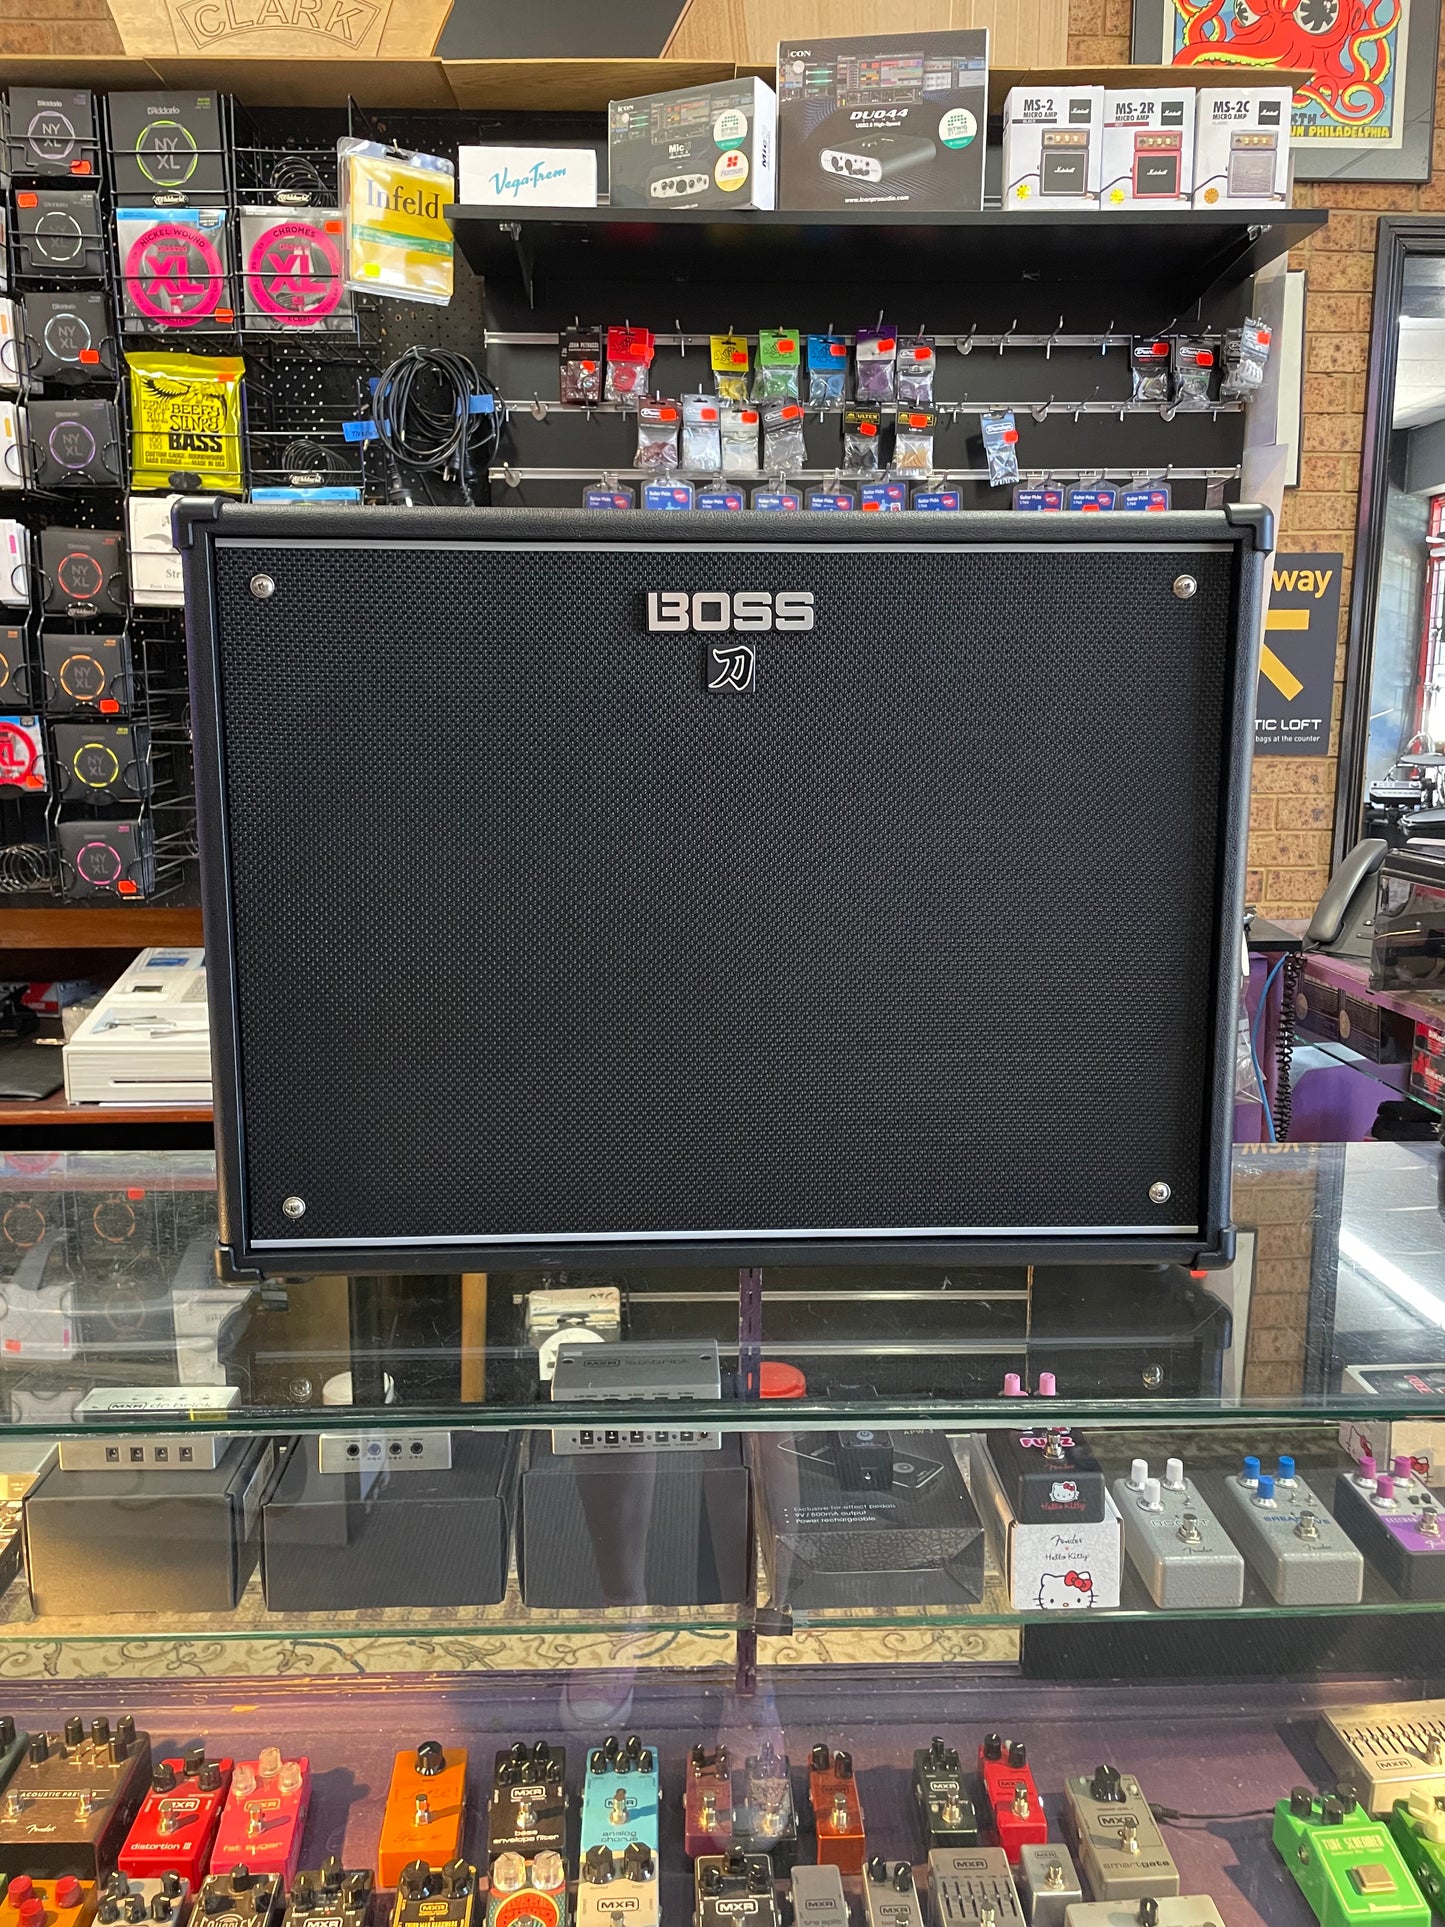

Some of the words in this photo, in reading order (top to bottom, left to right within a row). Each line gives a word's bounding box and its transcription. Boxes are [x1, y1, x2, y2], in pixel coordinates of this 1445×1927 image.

[194, 0, 364, 40] CLARK
[1023, 99, 1054, 112] MS-2
[1212, 100, 1250, 113] MS-2C
[42, 123, 60, 135] NY
[1308, 126, 1390, 138] PHILADELPHIA
[154, 137, 178, 151] NY
[157, 155, 180, 169] XL
[366, 178, 440, 220] Infeld
[273, 226, 316, 238] CHROMES
[140, 228, 171, 248] NICKEL
[173, 228, 206, 248] WOUND
[145, 255, 205, 295] XL
[267, 254, 327, 293] XL
[58, 326, 76, 337] NY
[60, 338, 78, 349] XL
[171, 404, 220, 415] BEEFY
[63, 433, 80, 443] NY
[168, 434, 223, 453] BASS
[66, 446, 83, 456] XL
[72, 565, 88, 575] NY
[72, 576, 90, 587] XL
[1272, 570, 1333, 599] way
[648, 592, 814, 631] BOSS
[74, 666, 91, 678] NY
[75, 678, 92, 689] XL
[1254, 719, 1277, 731] TIC
[1280, 719, 1323, 731] LOFT
[1255, 735, 1272, 744] bags
[1293, 735, 1321, 743] counter
[869, 1503, 897, 1511] pedals
[1041, 1502, 1062, 1511] Hello
[1063, 1501, 1086, 1511] Kitty
[821, 1516, 877, 1524] rechargeable
[1050, 1534, 1083, 1546] Fender
[1045, 1553, 1067, 1561] Hello
[1068, 1552, 1089, 1561] Kitty
[1380, 1760, 1408, 1768] MXR
[514, 1788, 542, 1796] MXR
[26, 1824, 56, 1834] Fender
[493, 1836, 536, 1844] envelope
[536, 1834, 559, 1842] filter
[1321, 1838, 1343, 1851] TUBE
[1344, 1835, 1385, 1848] SCREAMER
[131, 1842, 180, 1850] distortion
[1103, 1860, 1170, 1868] smartgate
[600, 1901, 635, 1909] MXR
[719, 1902, 753, 1912] MXR
